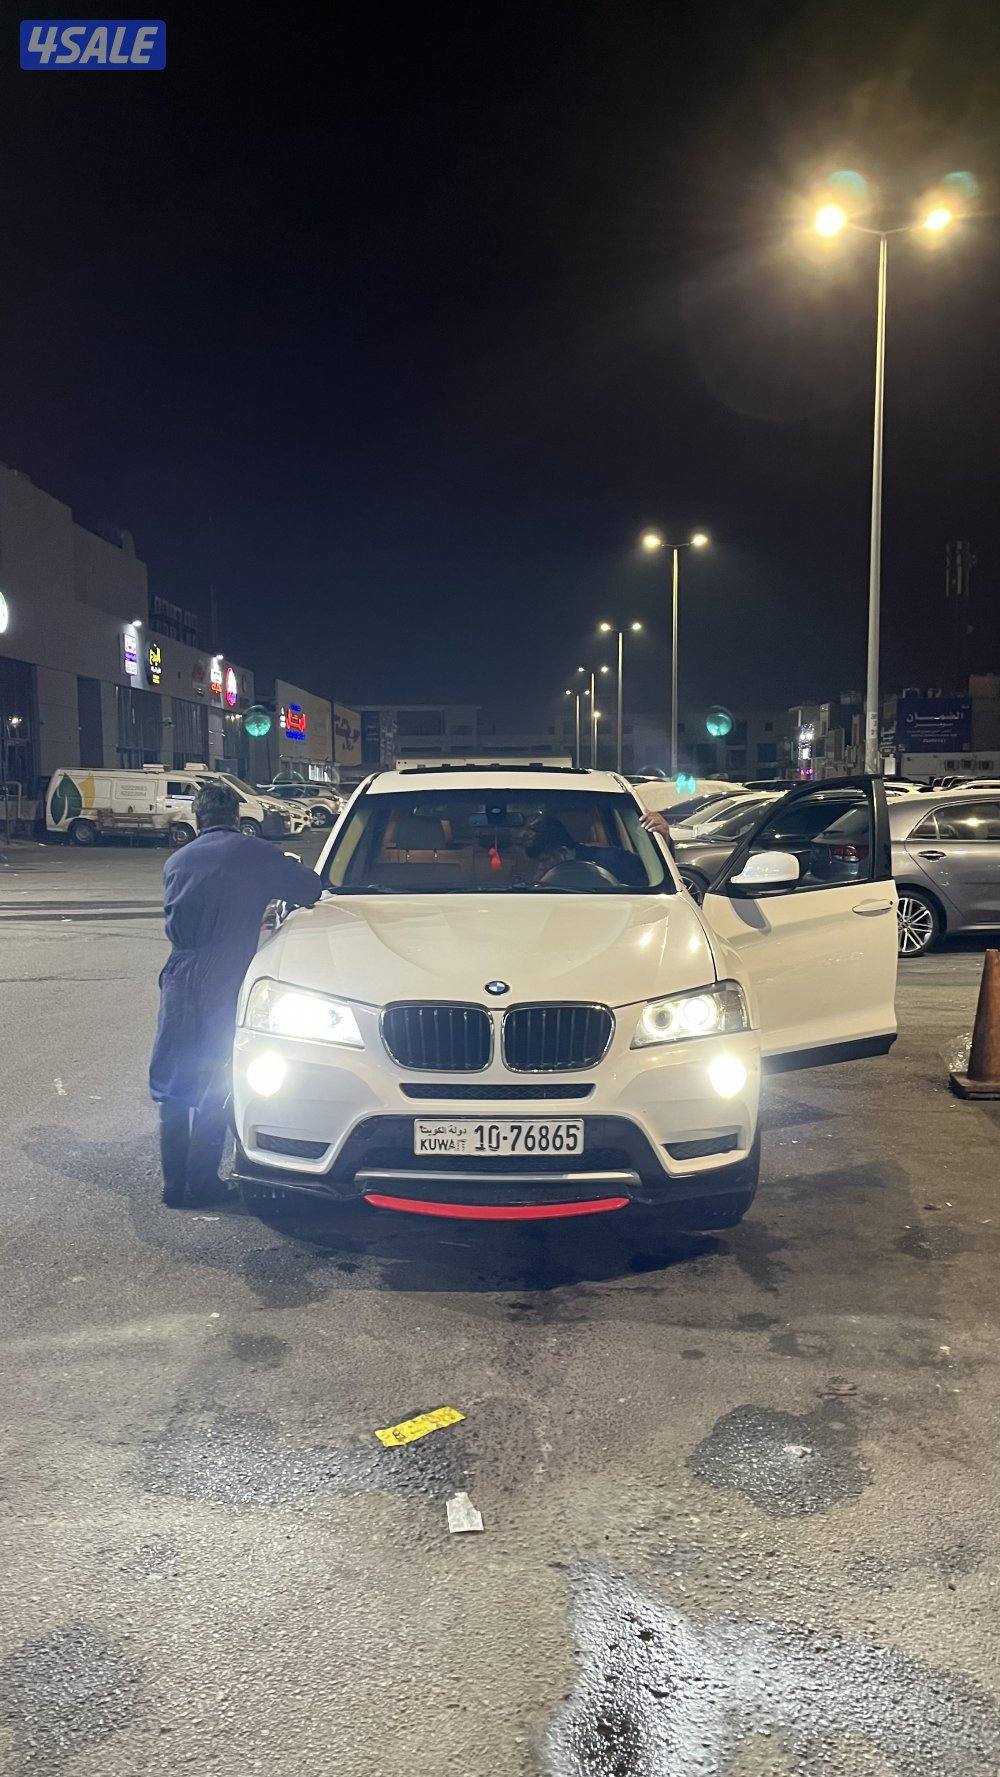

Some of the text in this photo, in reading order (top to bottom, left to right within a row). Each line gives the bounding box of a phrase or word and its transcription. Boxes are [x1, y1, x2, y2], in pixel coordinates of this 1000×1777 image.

[419, 1124, 467, 1136] دولة الكويت
[420, 1138, 467, 1152] KUWAIT
